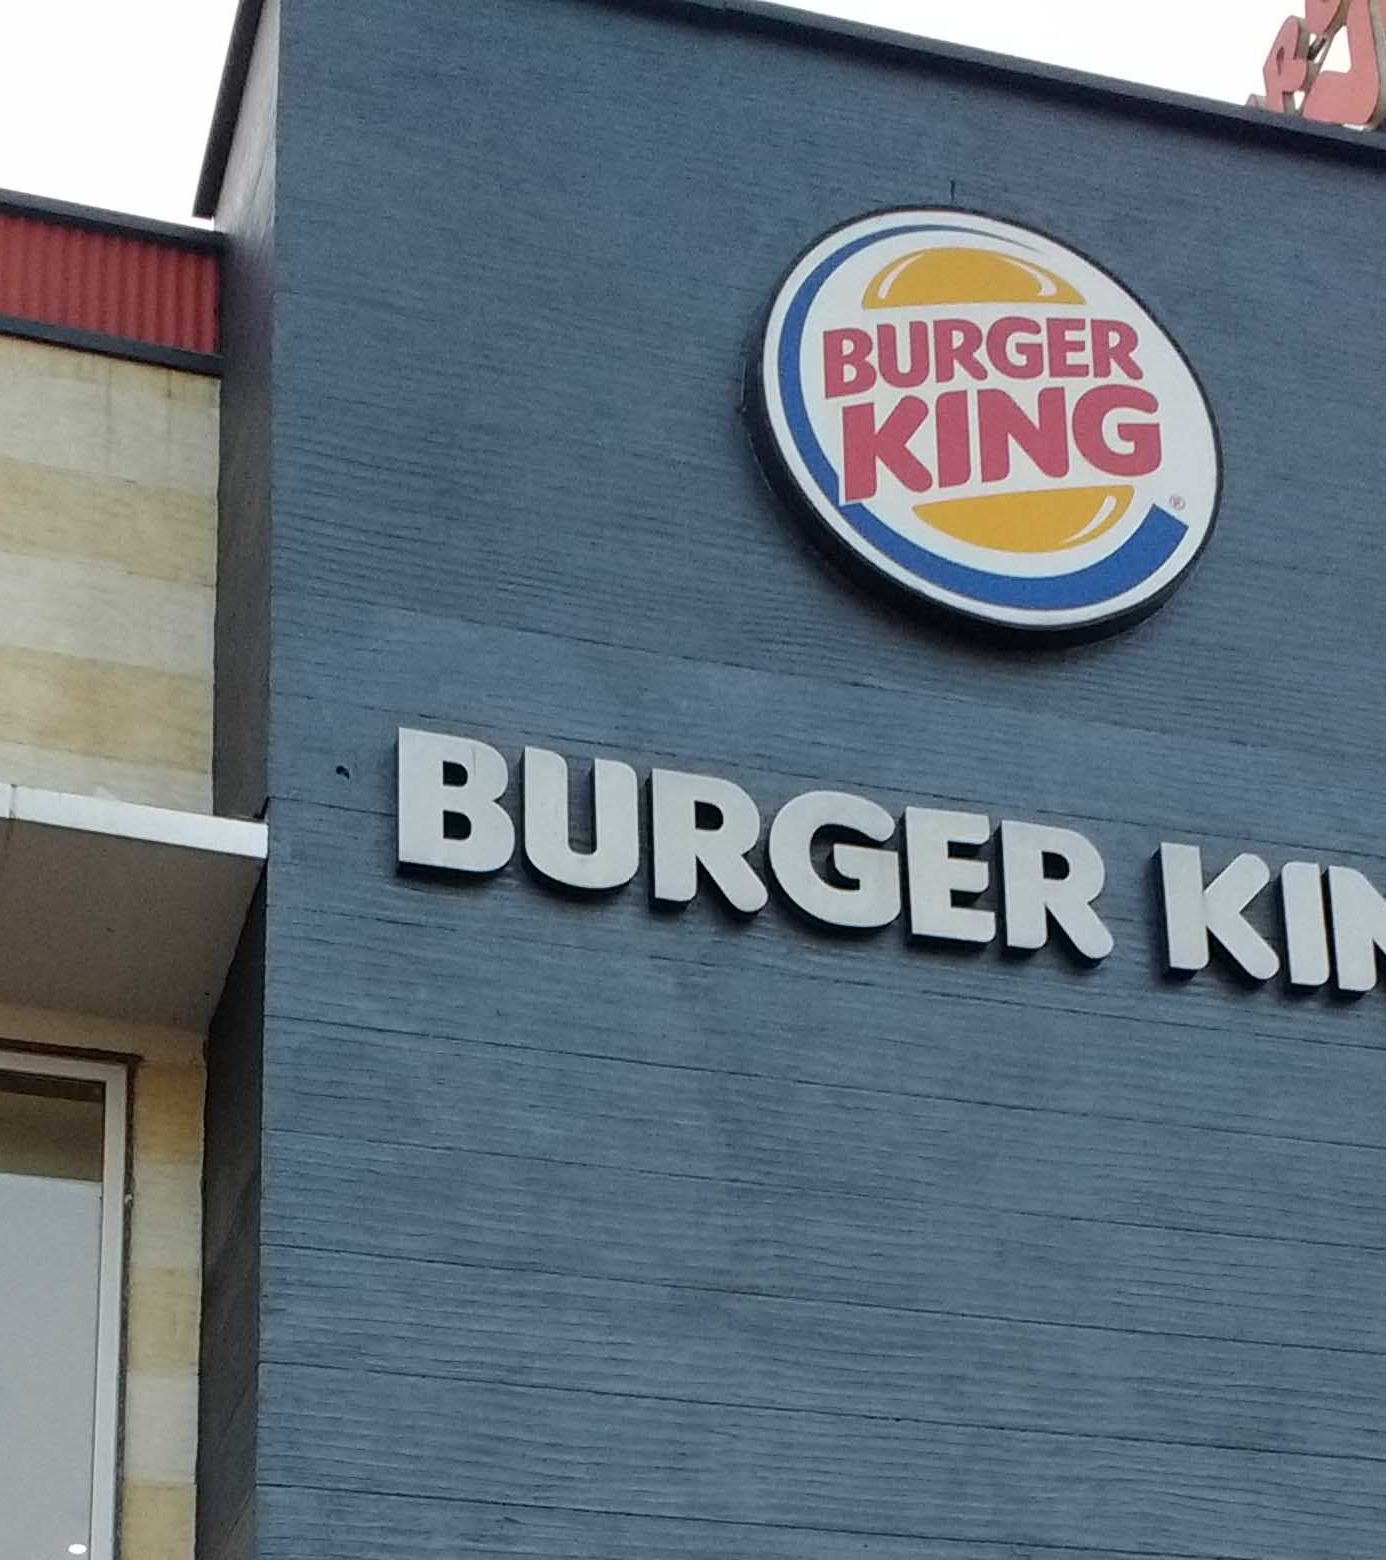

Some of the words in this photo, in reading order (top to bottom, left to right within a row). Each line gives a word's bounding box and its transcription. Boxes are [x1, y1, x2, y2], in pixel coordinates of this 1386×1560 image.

[823, 316, 1144, 399] BURGER
[842, 384, 1162, 502] KING
[395, 727, 1116, 966] BURGER
